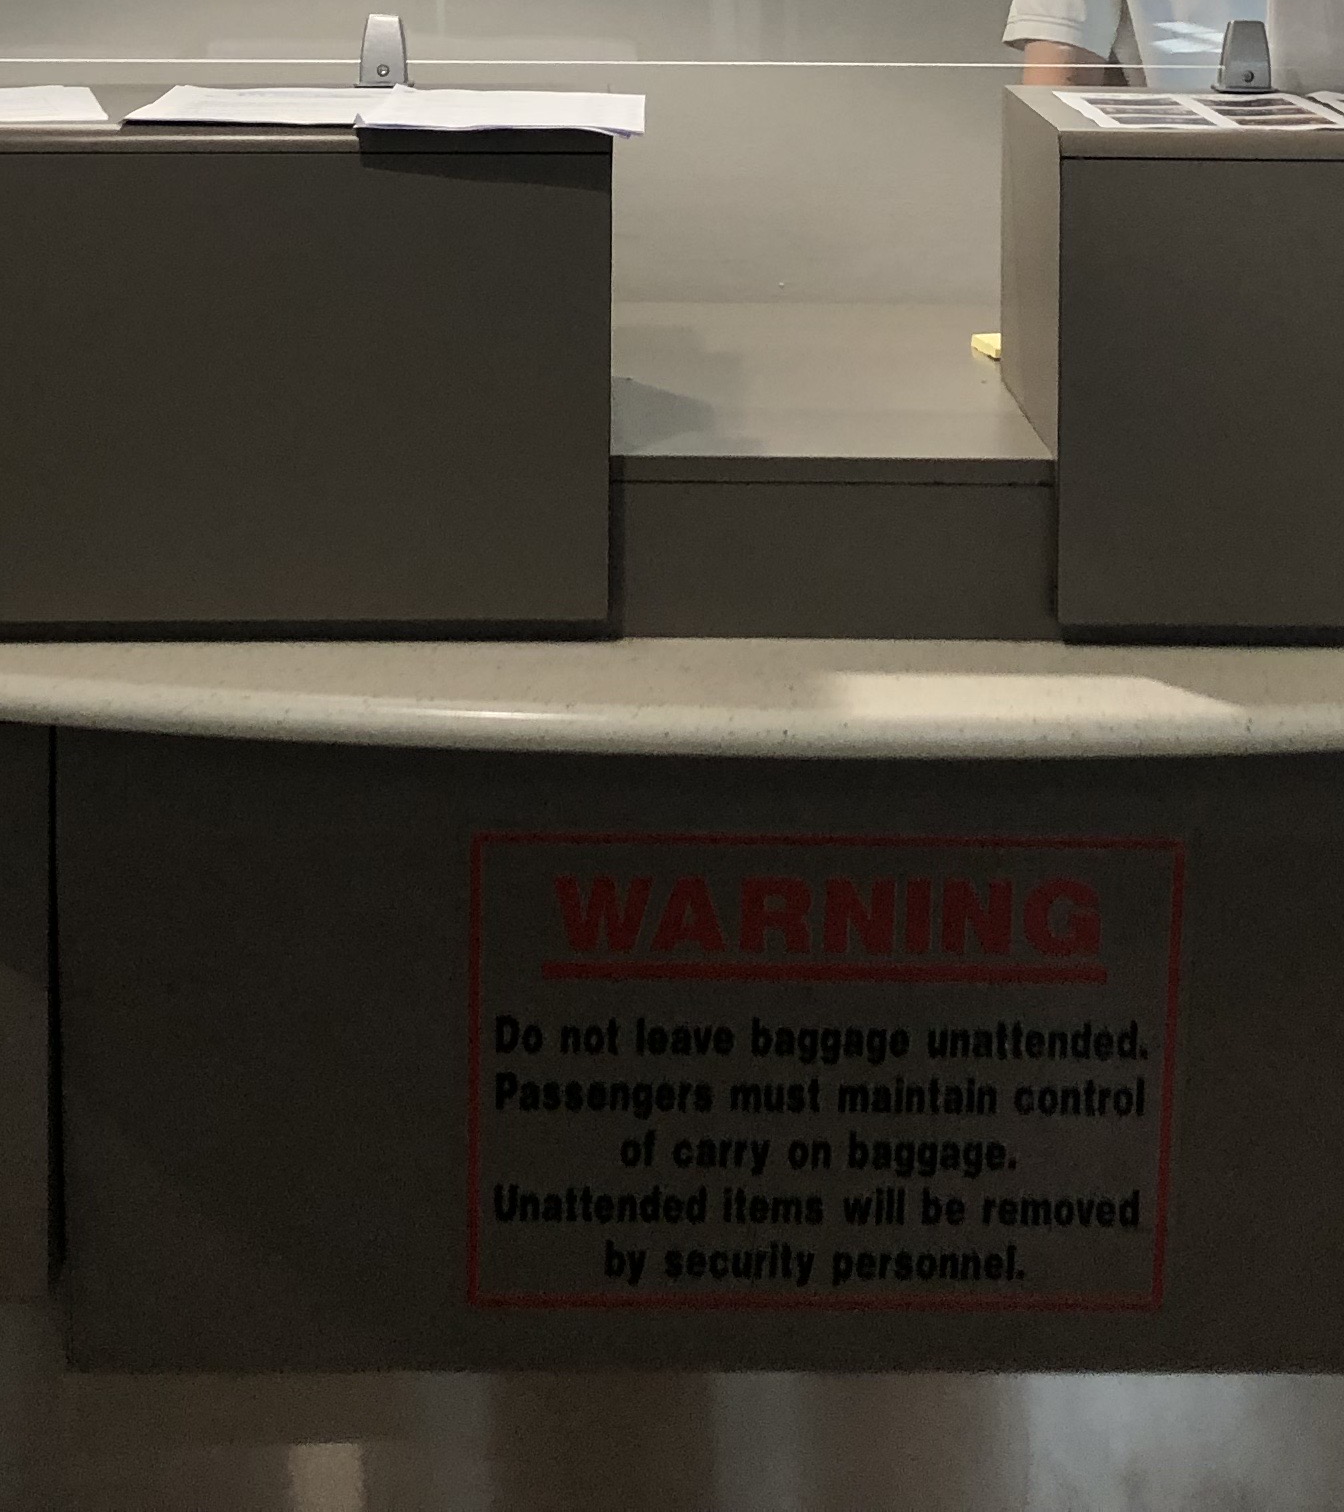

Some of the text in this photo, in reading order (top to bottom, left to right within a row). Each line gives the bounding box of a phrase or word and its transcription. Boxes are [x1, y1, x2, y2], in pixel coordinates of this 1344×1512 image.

[555, 874, 1102, 956] WARNING
[494, 1015, 1149, 1064] Do not leave baggage unattended.
[494, 1071, 1146, 1119] Passengers must maintain control
[620, 1130, 1018, 1178] of carry on baggage.
[493, 1184, 1141, 1228] Unattended items will be removed
[604, 1239, 1026, 1286] by security personnel.
